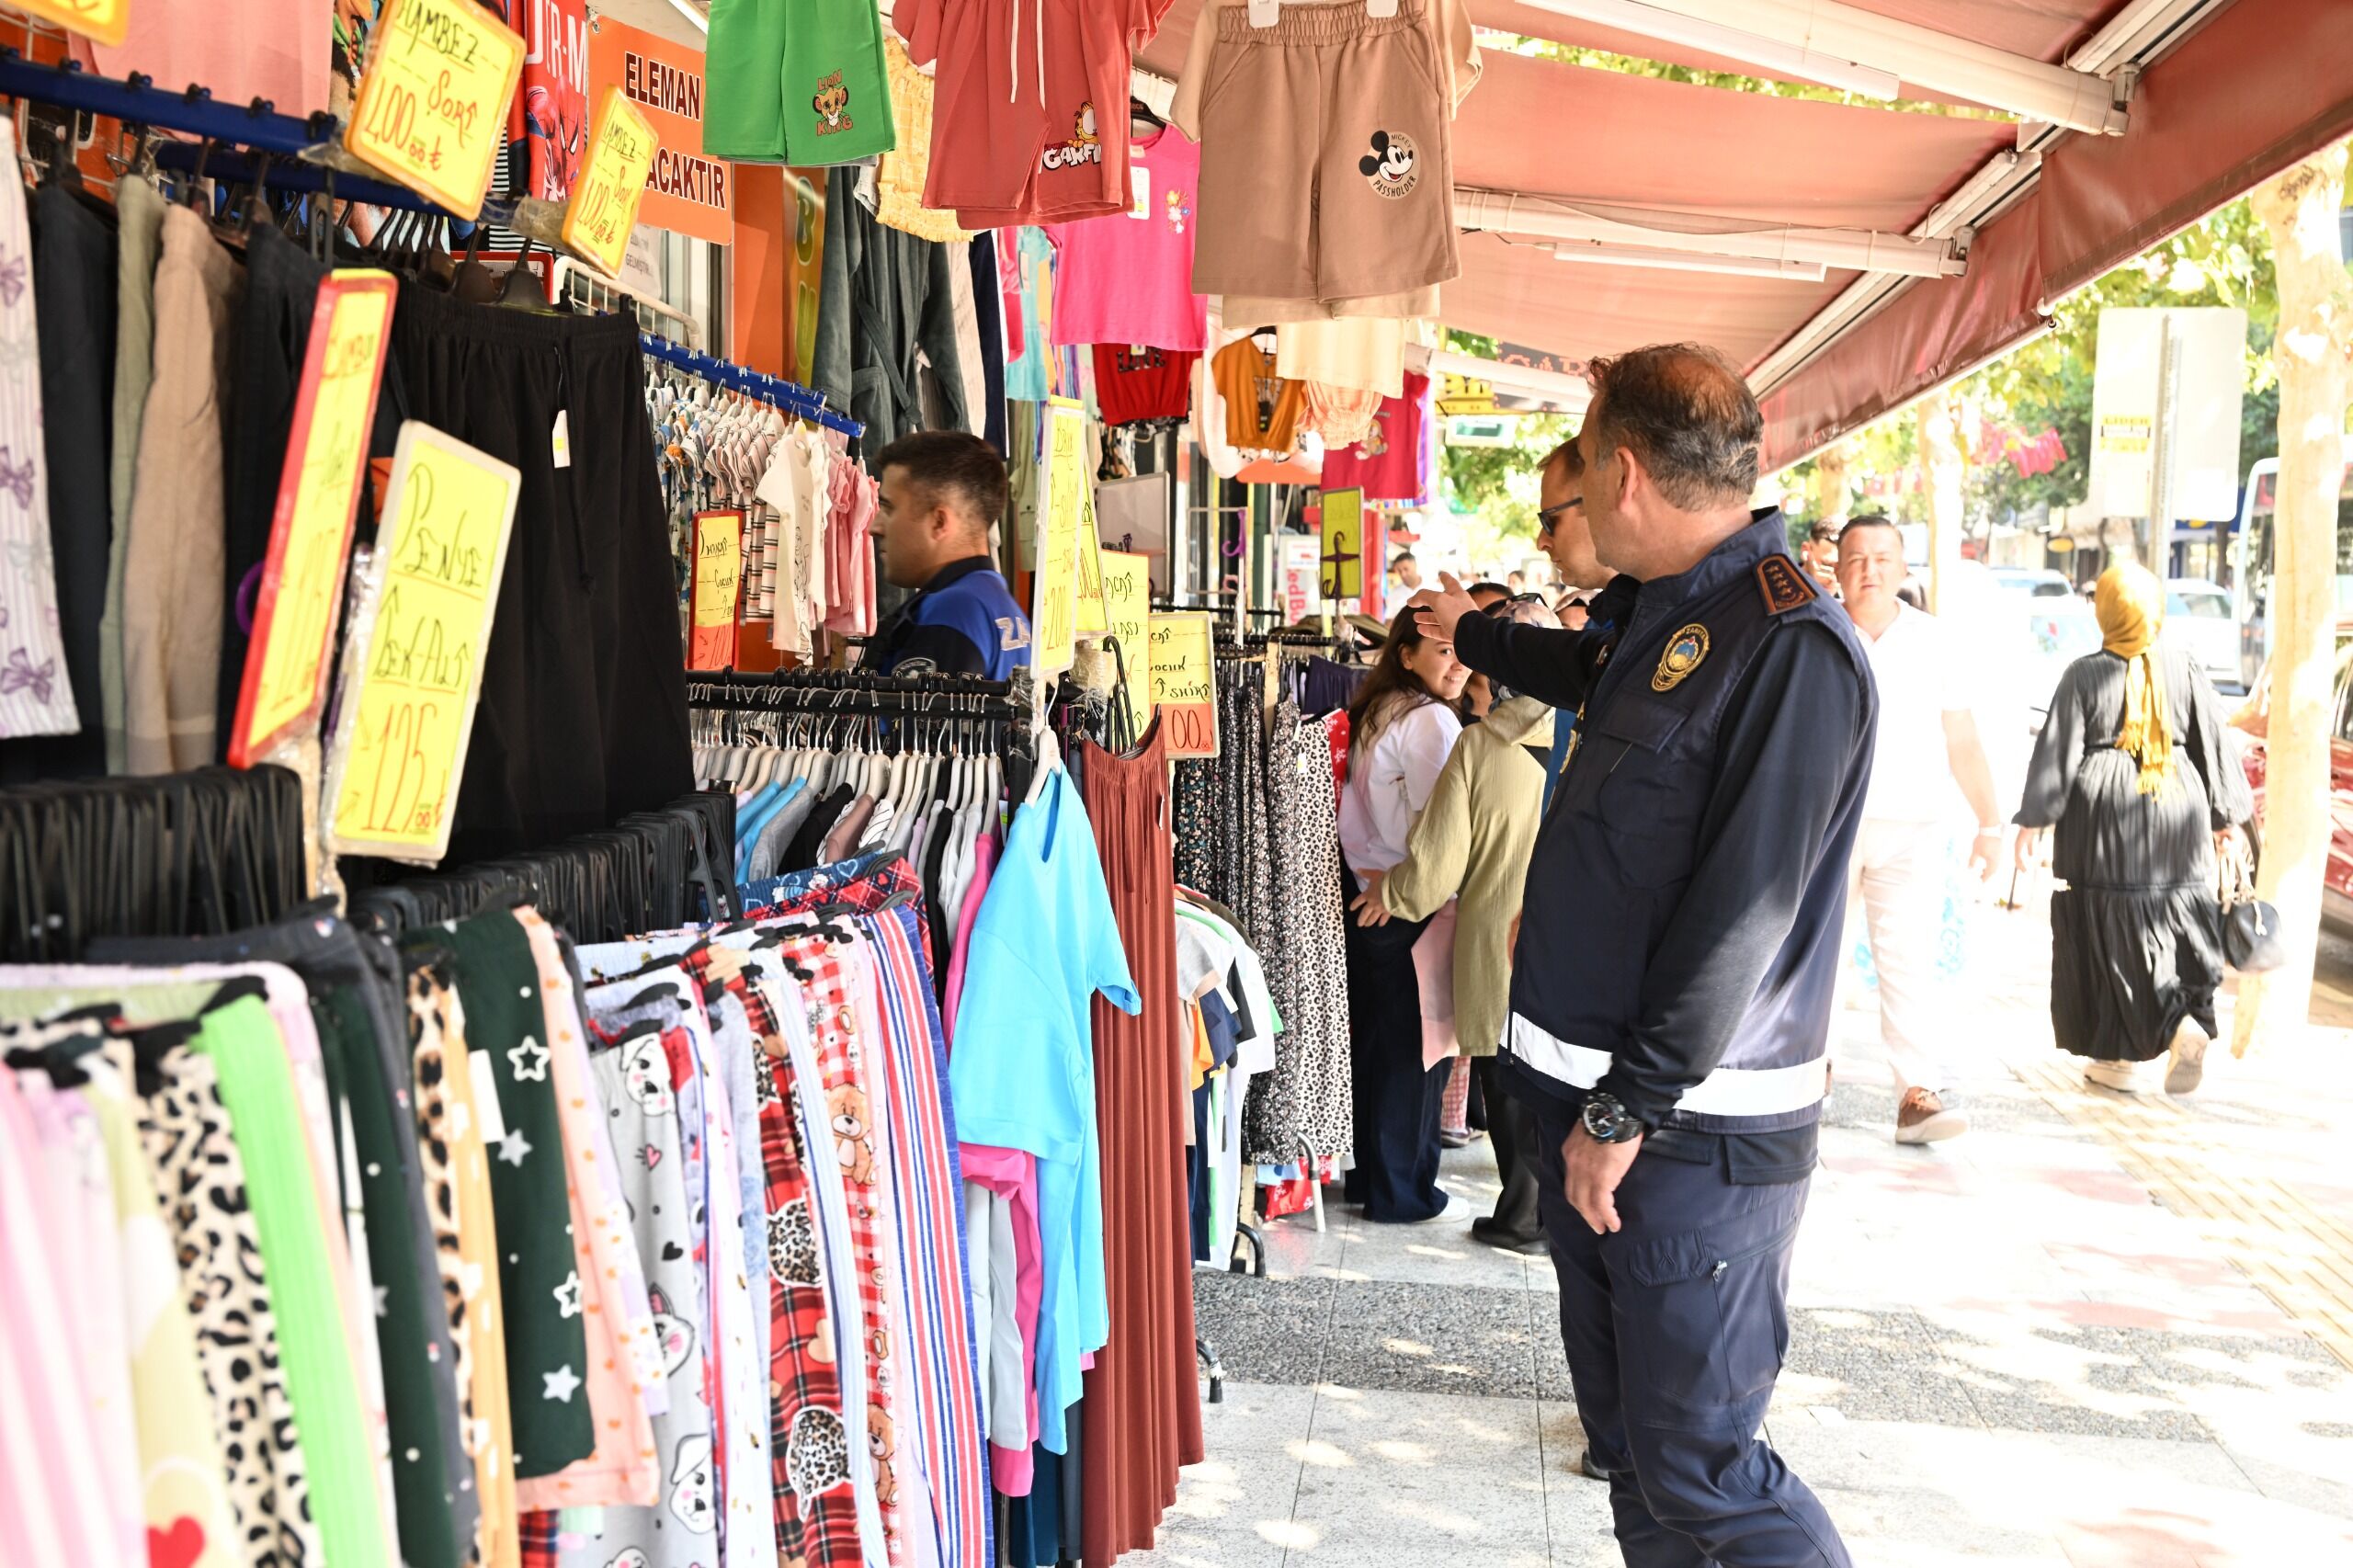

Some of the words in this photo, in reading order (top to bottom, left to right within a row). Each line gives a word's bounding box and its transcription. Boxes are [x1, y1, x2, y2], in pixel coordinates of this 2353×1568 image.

[625, 51, 701, 121] ELEMAN
[817, 68, 842, 91] LION
[816, 115, 853, 136] KING
[1391, 134, 1413, 148] MICKEY
[1043, 143, 1102, 170] GARFI
[644, 147, 726, 210] ACAKTIR
[1373, 176, 1416, 198] PASSHOLDER
[1150, 655, 1186, 672] OCUK
